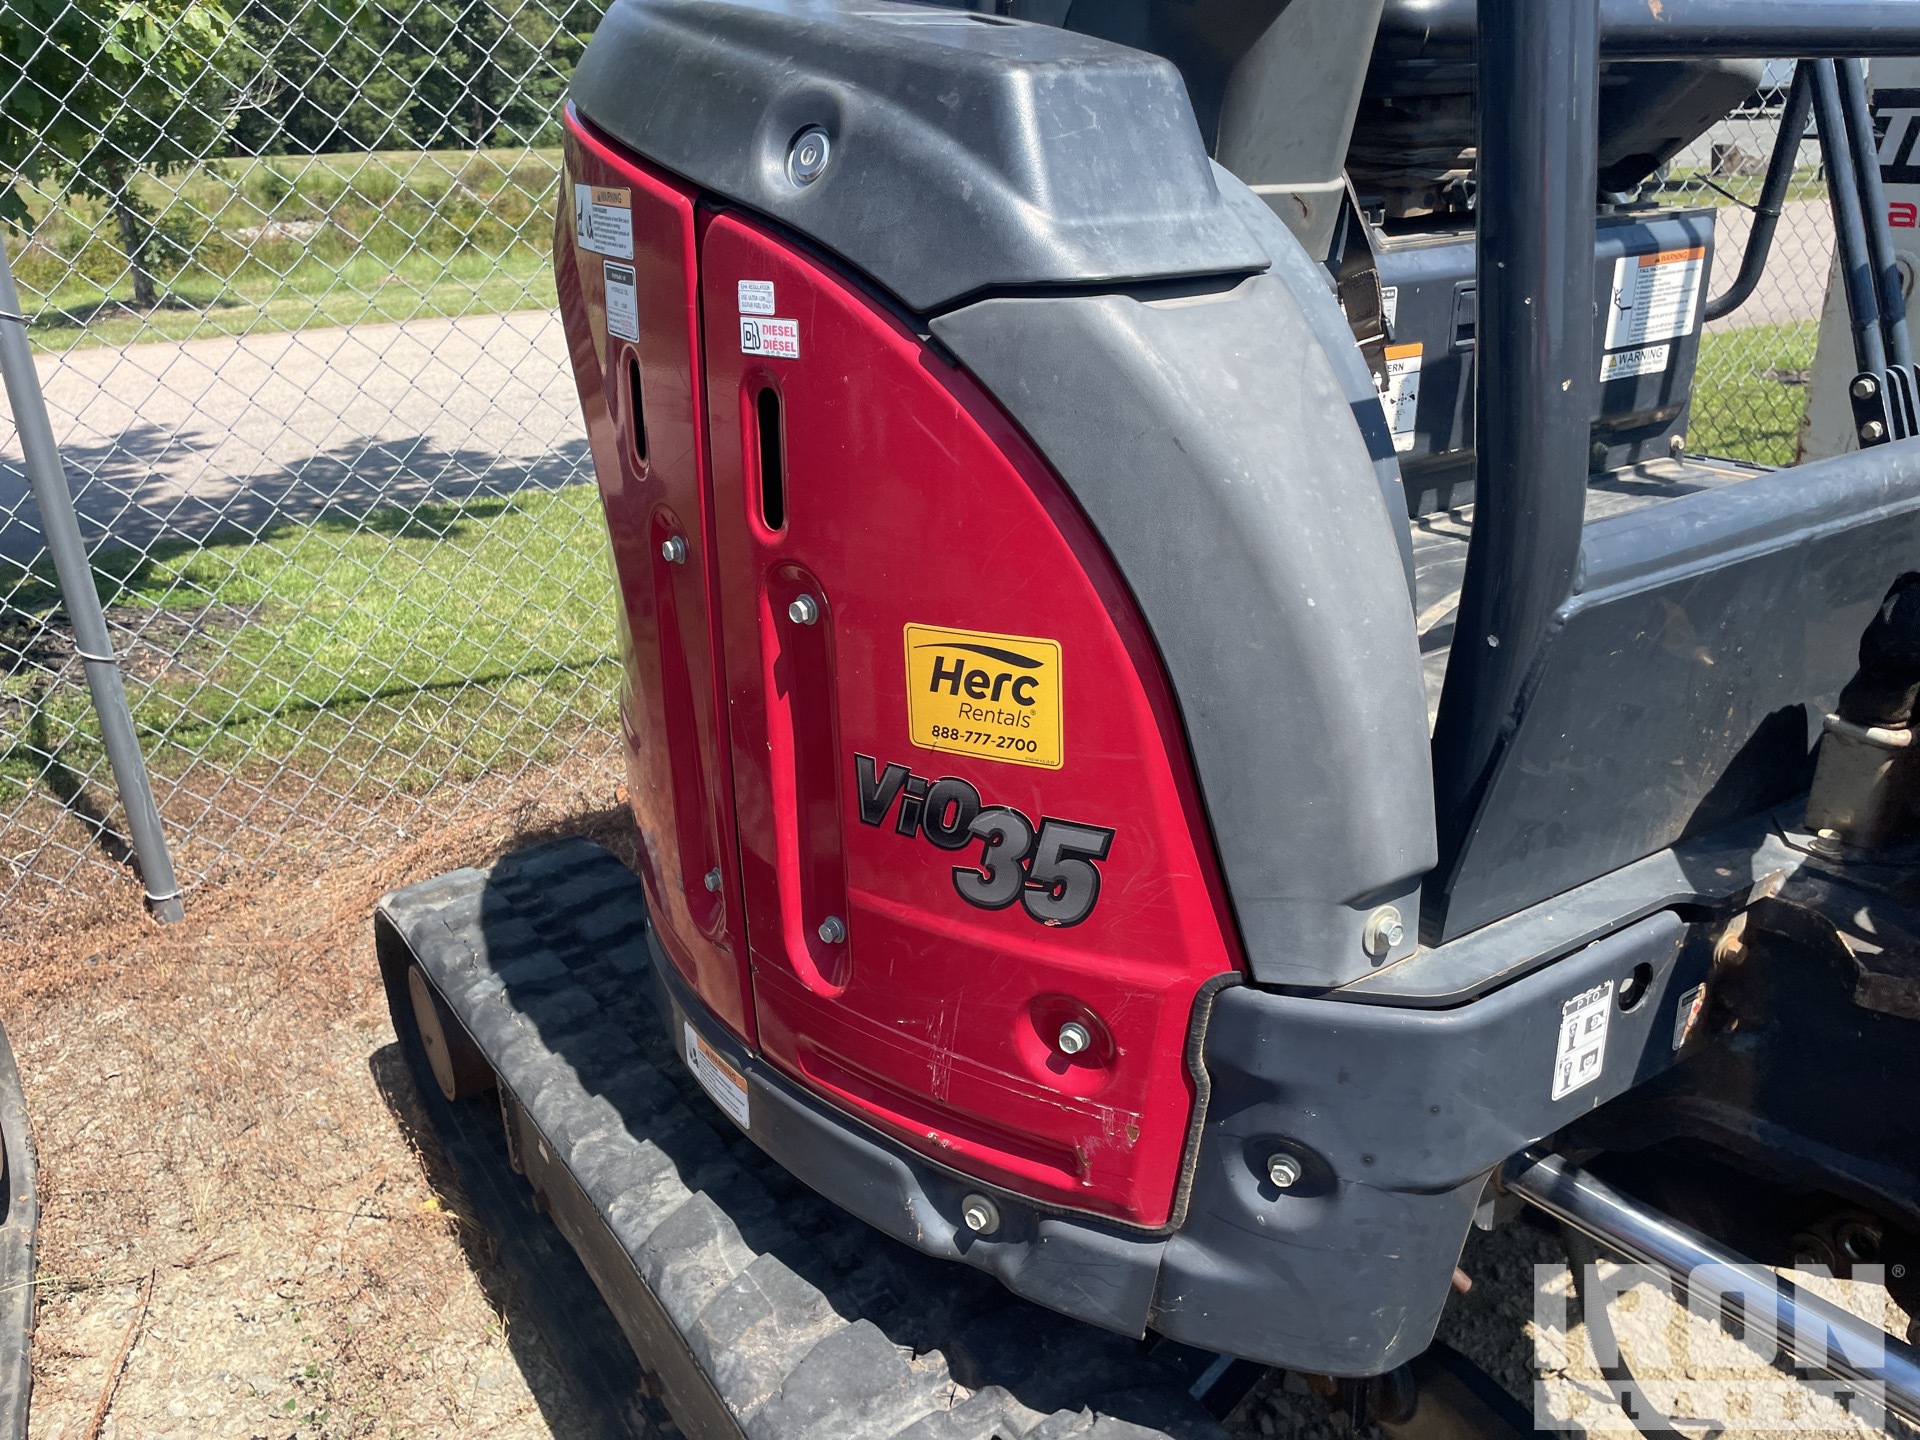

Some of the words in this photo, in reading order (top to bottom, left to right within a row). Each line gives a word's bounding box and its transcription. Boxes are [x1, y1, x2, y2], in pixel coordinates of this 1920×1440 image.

[1876, 108, 1920, 166] T
[1661, 252, 1688, 263] WARNING
[762, 325, 796, 337] DIESEL
[763, 338, 796, 351] DIÉSEL
[1619, 347, 1663, 363] WARNING
[929, 655, 1040, 707] Herc
[931, 726, 1038, 753] 888-777-2700
[1576, 991, 1600, 1011] PTO
